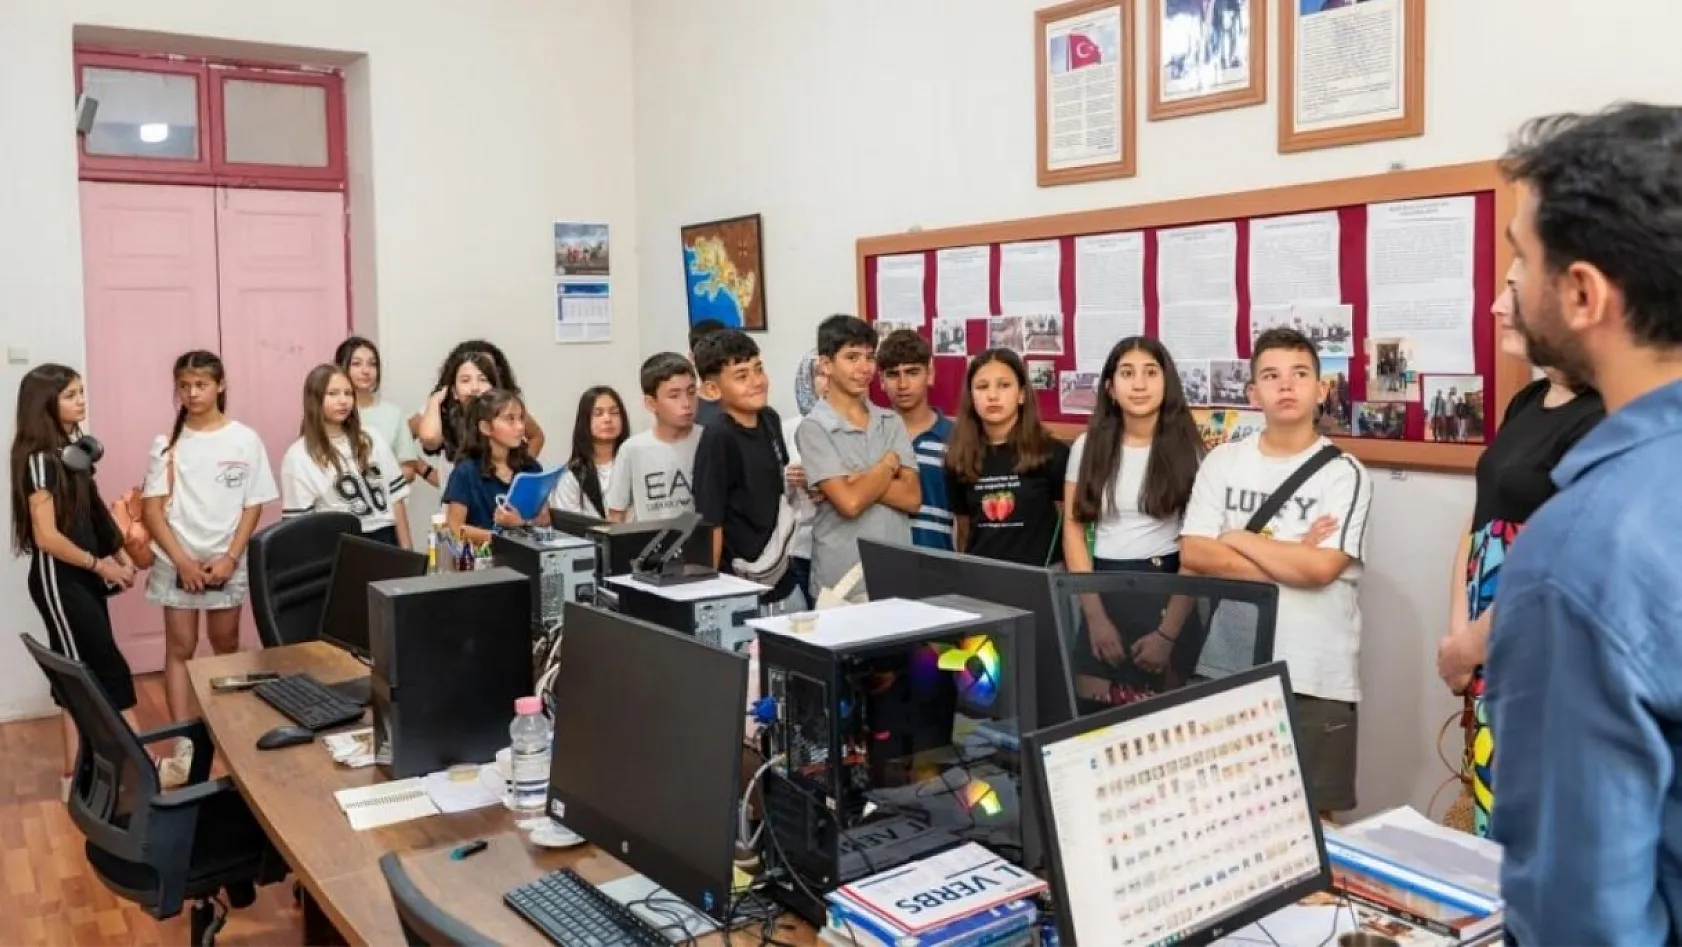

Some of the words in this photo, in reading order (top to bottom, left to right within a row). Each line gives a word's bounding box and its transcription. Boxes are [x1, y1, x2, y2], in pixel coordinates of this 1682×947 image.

[334, 464, 387, 515] 96
[1225, 486, 1318, 520] LUY
[894, 874, 1001, 914] VERBS
